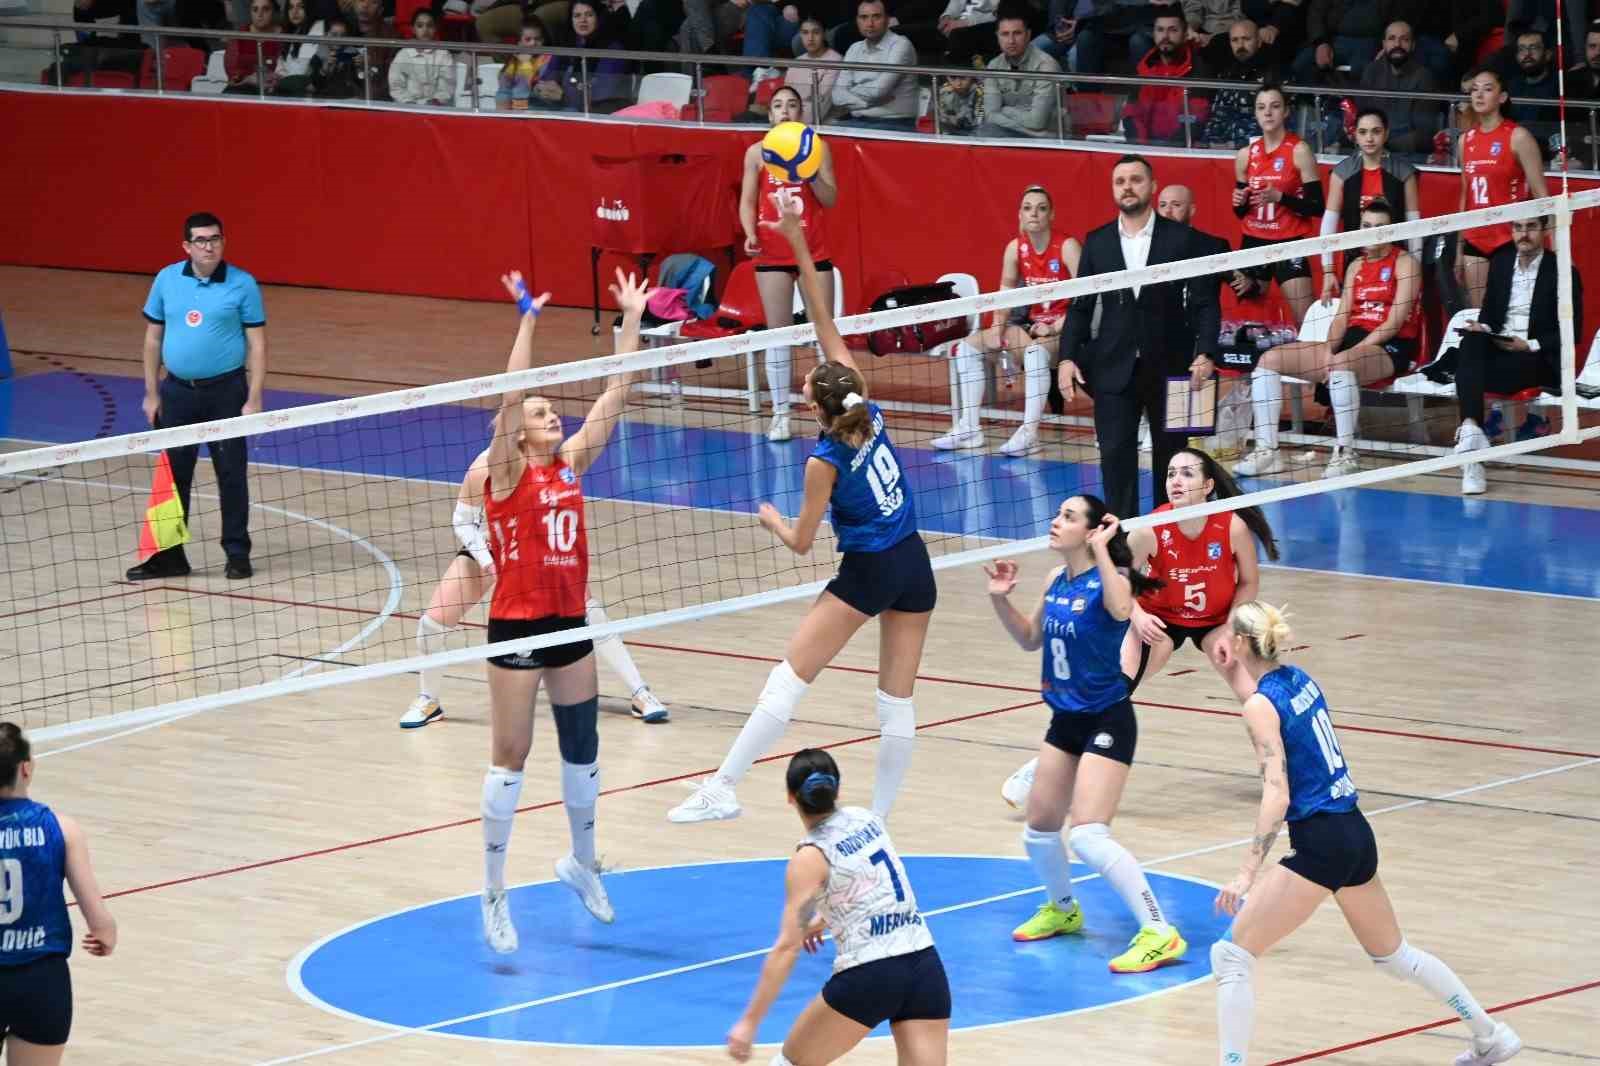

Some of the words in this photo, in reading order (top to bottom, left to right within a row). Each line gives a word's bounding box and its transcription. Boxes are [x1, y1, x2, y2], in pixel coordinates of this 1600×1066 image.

[1471, 176, 1489, 204] 12
[866, 443, 900, 505] 19
[541, 508, 578, 553] 10
[1183, 582, 1206, 612] 5
[1050, 637, 1071, 680] 8
[1311, 707, 1344, 775] 10
[869, 847, 905, 902] 7
